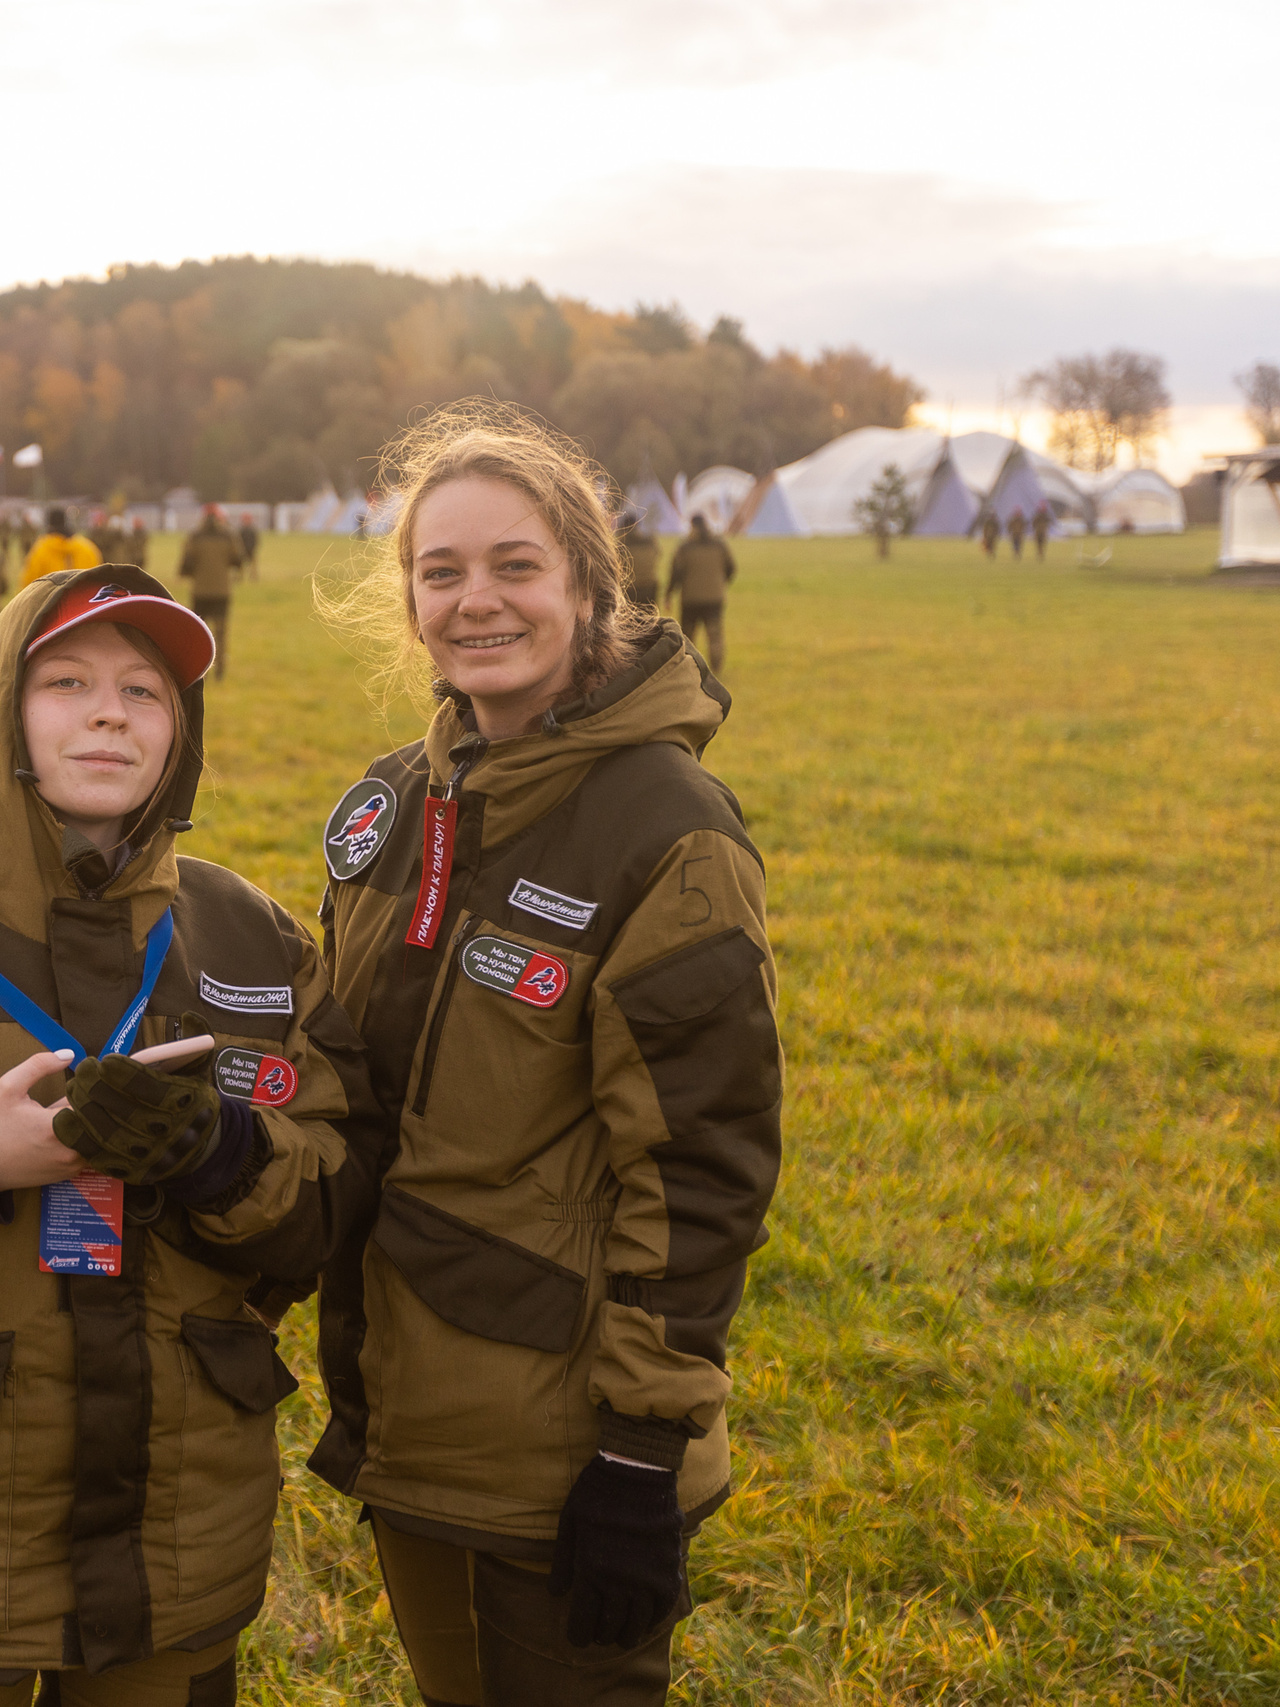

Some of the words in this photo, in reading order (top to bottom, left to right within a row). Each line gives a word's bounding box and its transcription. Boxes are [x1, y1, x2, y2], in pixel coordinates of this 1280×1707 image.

[433, 822, 446, 874] ПЛЕЧУ!
[431, 873, 441, 887] К
[679, 854, 713, 928] 5
[417, 885, 439, 943] ПЛЕЧОМ
[470, 950, 487, 963] где
[488, 957, 521, 975] нужна
[490, 946, 507, 959] Мы
[508, 953, 527, 967] там,
[475, 963, 516, 984] помощь
[219, 1066, 231, 1076] где
[231, 1068, 256, 1080] нужна
[231, 1056, 245, 1067] Мы
[245, 1061, 259, 1071] там,
[224, 1078, 253, 1091] помощь
